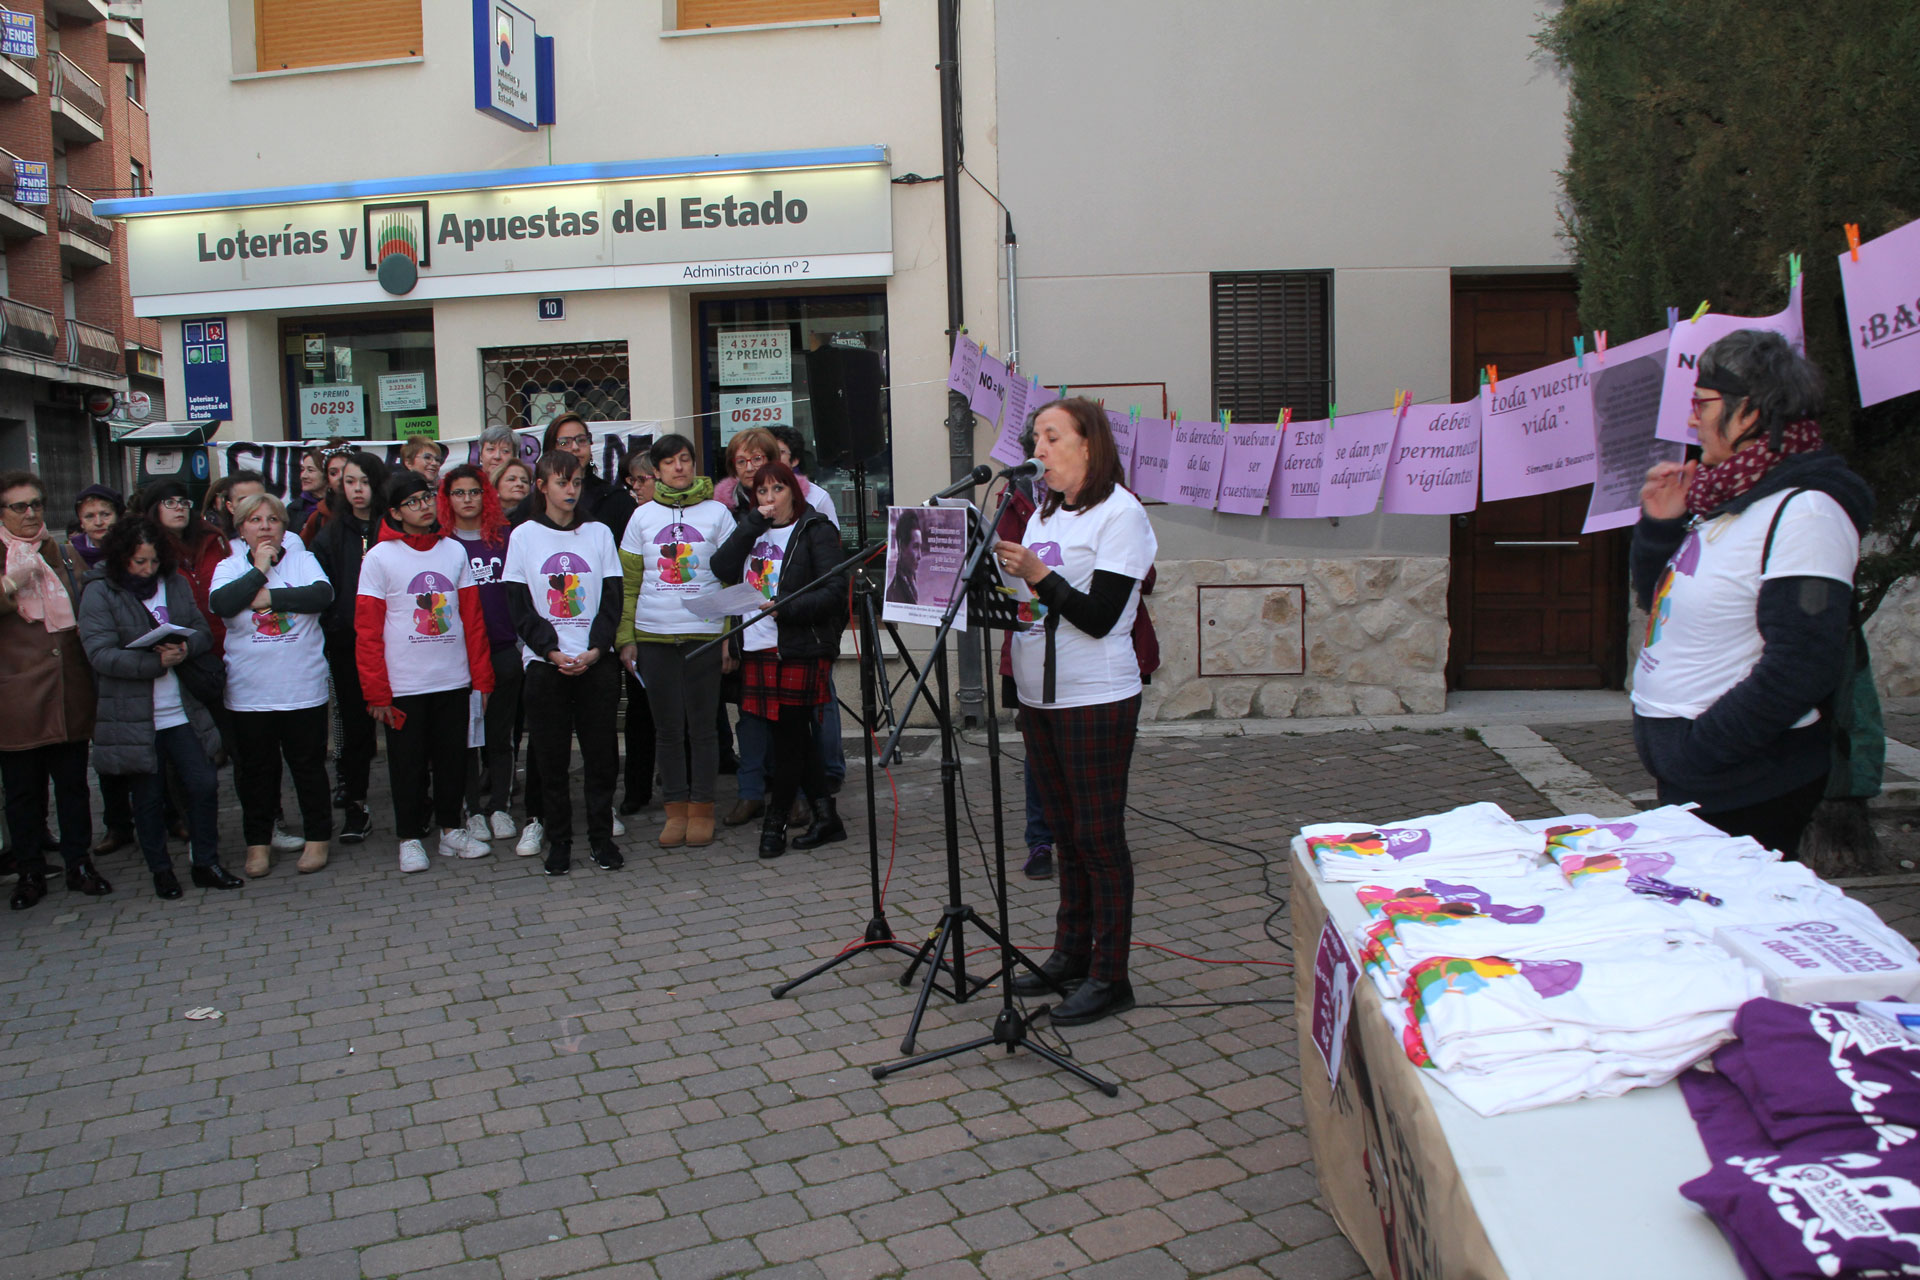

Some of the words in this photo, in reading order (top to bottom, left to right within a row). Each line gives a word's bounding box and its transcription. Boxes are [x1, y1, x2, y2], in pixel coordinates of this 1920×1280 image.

[498, 79, 519, 98] Apuestas
[498, 91, 514, 107] Estado
[25, 163, 44, 174] HT
[198, 224, 328, 262] Loterías
[339, 227, 357, 261] y
[437, 205, 599, 251] Apuestas
[612, 197, 667, 234] del
[680, 191, 808, 230] Estado
[682, 261, 780, 280] Administración
[783, 261, 799, 275] nº
[802, 260, 810, 274] 2
[544, 301, 557, 316] 10
[737, 349, 782, 360] PREMIO
[979, 372, 993, 390] NO
[323, 390, 350, 398] PREMIO
[746, 396, 777, 405] PREMIO
[1491, 385, 1527, 414] toda
[190, 404, 218, 412] Apuestas
[219, 402, 228, 410] del
[311, 401, 354, 415] 06293
[731, 408, 782, 423] 06293
[405, 420, 432, 428] UNICO
[1176, 427, 1188, 443] los
[1189, 430, 1225, 446] derechos
[1233, 430, 1269, 446] vuelvan
[1270, 437, 1276, 446] a
[1336, 447, 1346, 460] se
[1348, 441, 1370, 458] dan
[1370, 441, 1389, 461] por
[1395, 439, 1478, 464] permanecer
[1137, 455, 1157, 469] para
[1159, 458, 1168, 473] qu
[1187, 455, 1198, 470] de
[1199, 455, 1211, 472] las
[1248, 461, 1261, 473] ser
[1525, 463, 1553, 475] Simone
[1555, 457, 1564, 469] de
[1330, 464, 1383, 489] adquiridos
[1406, 467, 1473, 492] vigilantes
[1180, 484, 1212, 502] mujeres
[1834, 939, 1903, 971] MARZO
[1833, 1188, 1886, 1231] MARZO
